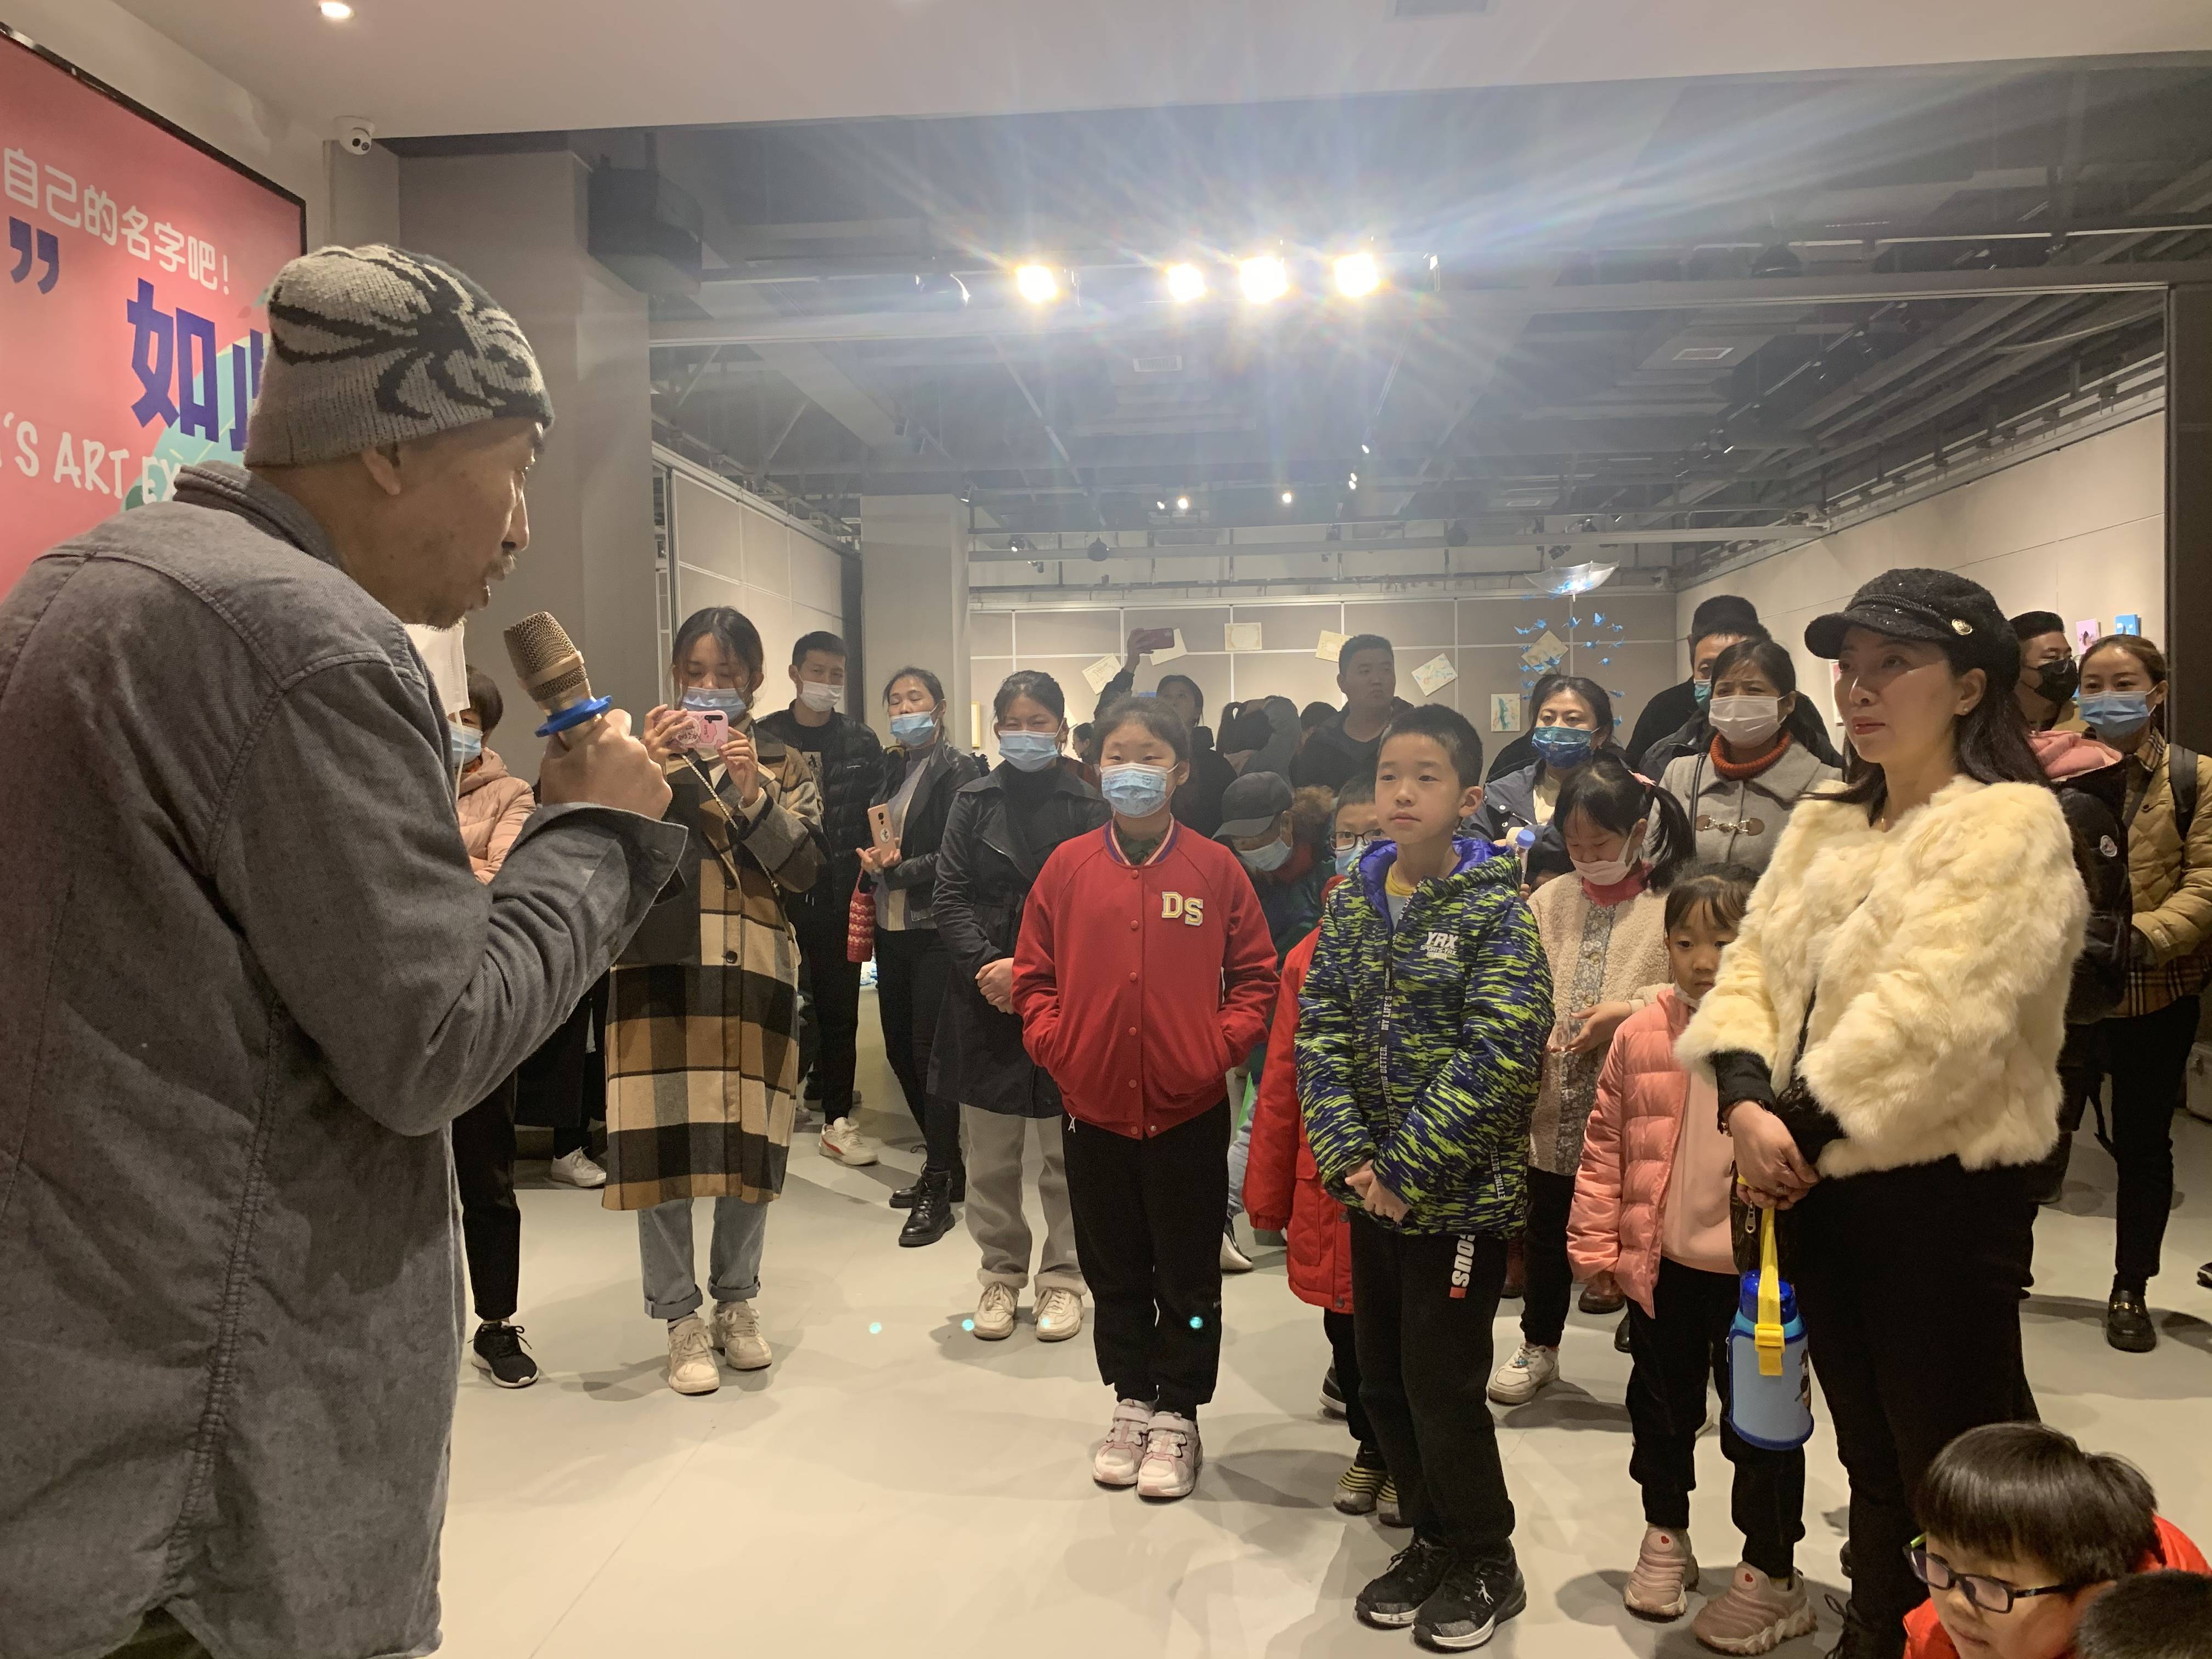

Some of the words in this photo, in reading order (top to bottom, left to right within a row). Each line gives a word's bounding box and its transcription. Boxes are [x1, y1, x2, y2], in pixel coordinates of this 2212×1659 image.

[4, 147, 231, 295] 自己的名字吧!
[0, 411, 40, 477] 'S
[54, 432, 129, 499] ART
[142, 456, 181, 505] EX
[1161, 891, 1204, 927] DS
[1383, 996, 1393, 1018] LIFE'S
[1381, 1019, 1390, 1030] MY
[1494, 1173, 1506, 1199] ETTING
